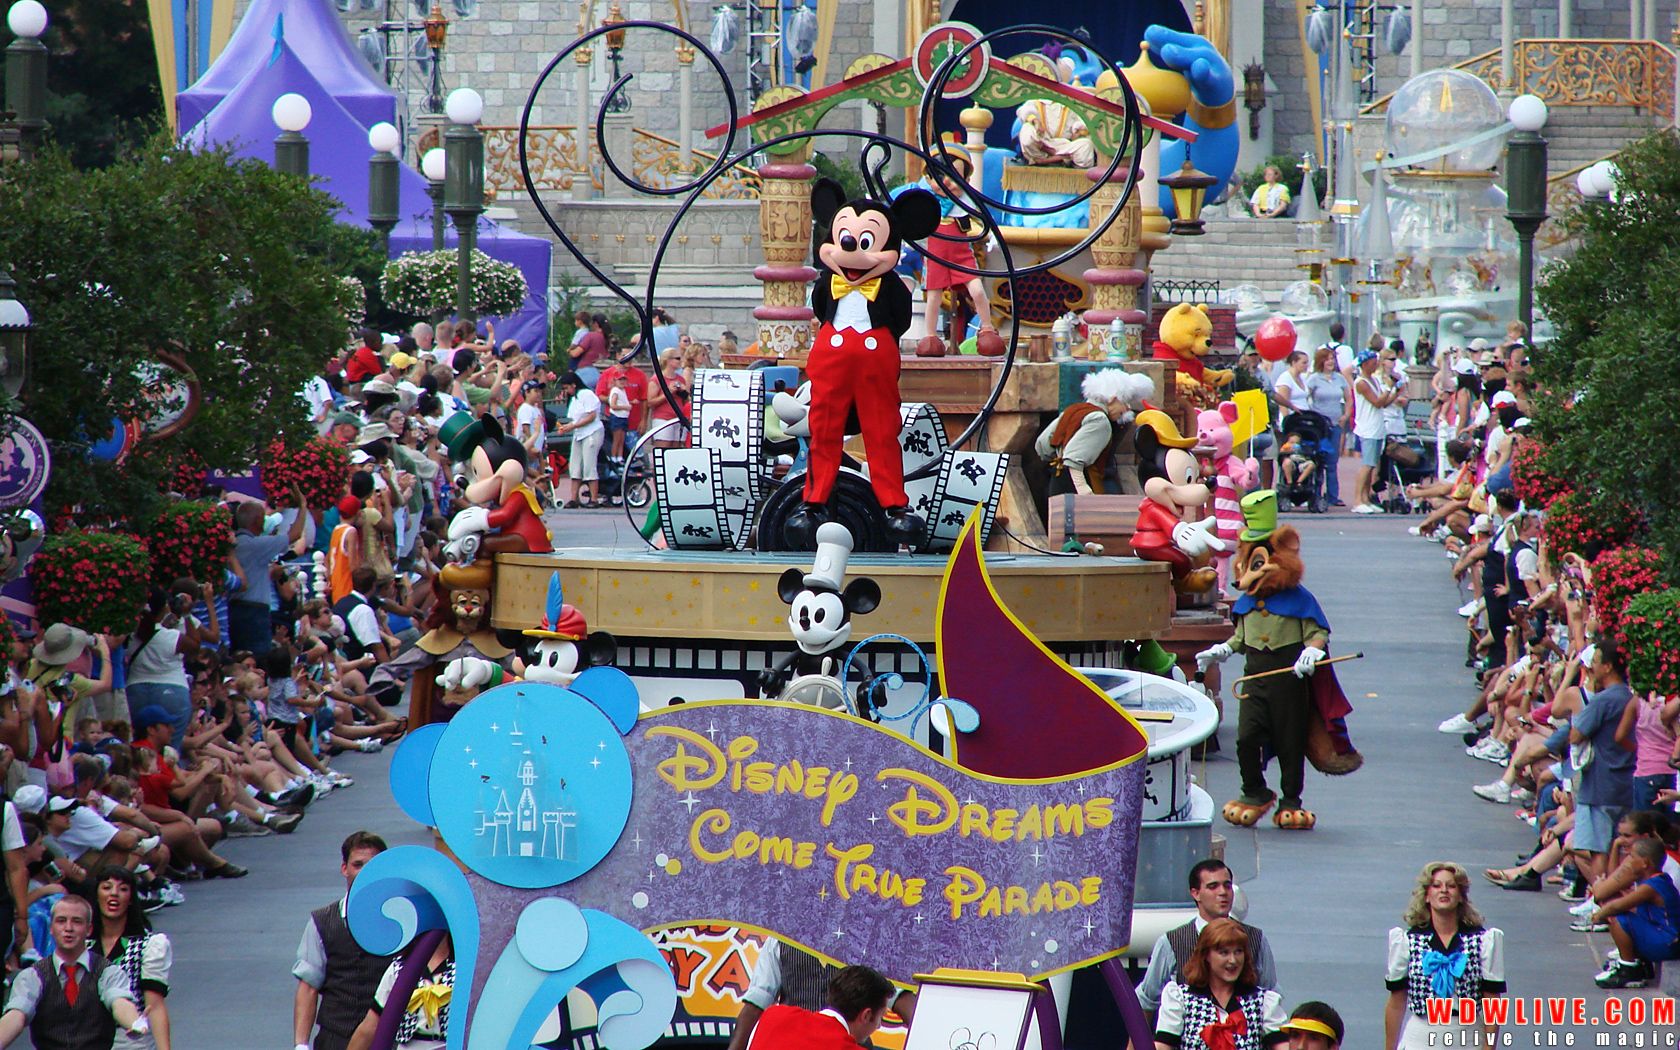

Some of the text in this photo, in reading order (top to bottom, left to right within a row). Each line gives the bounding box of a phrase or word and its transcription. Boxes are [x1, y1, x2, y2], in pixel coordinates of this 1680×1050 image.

[876, 768, 1113, 841] DREAMS
[690, 809, 1102, 919] COME TRUE PARADE
